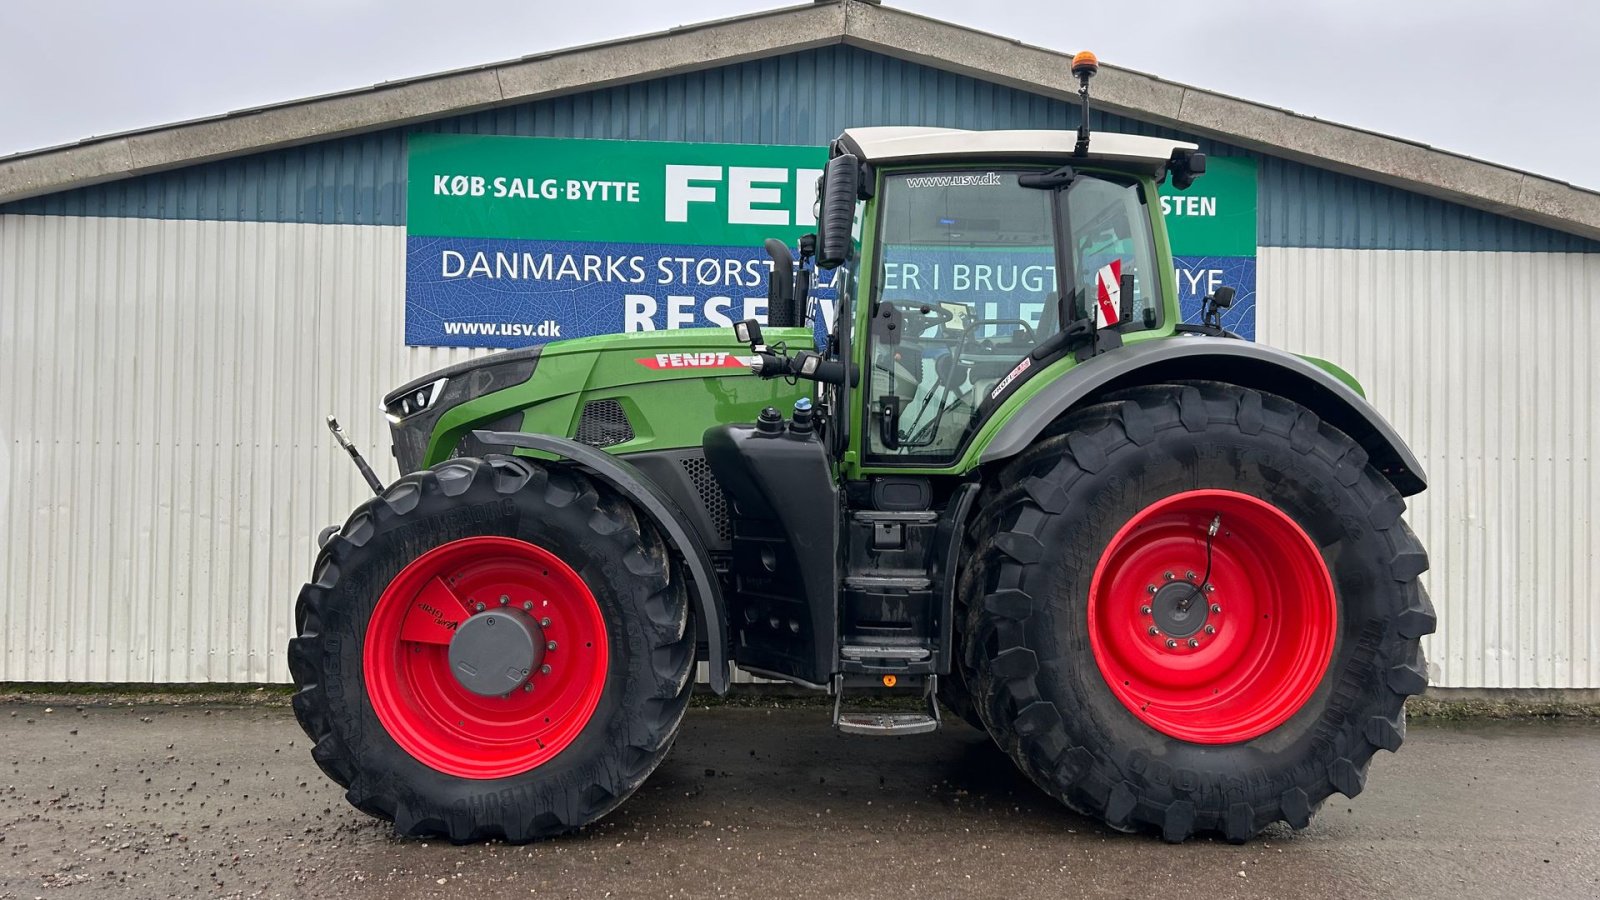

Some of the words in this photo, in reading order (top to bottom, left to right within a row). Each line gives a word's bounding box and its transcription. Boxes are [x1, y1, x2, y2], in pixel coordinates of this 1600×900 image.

[906, 172, 1001, 188] www.usv.dk
[441, 250, 646, 283] DANMARKS
[443, 320, 561, 337] www.usv.dk
[655, 351, 730, 368] FENDT
